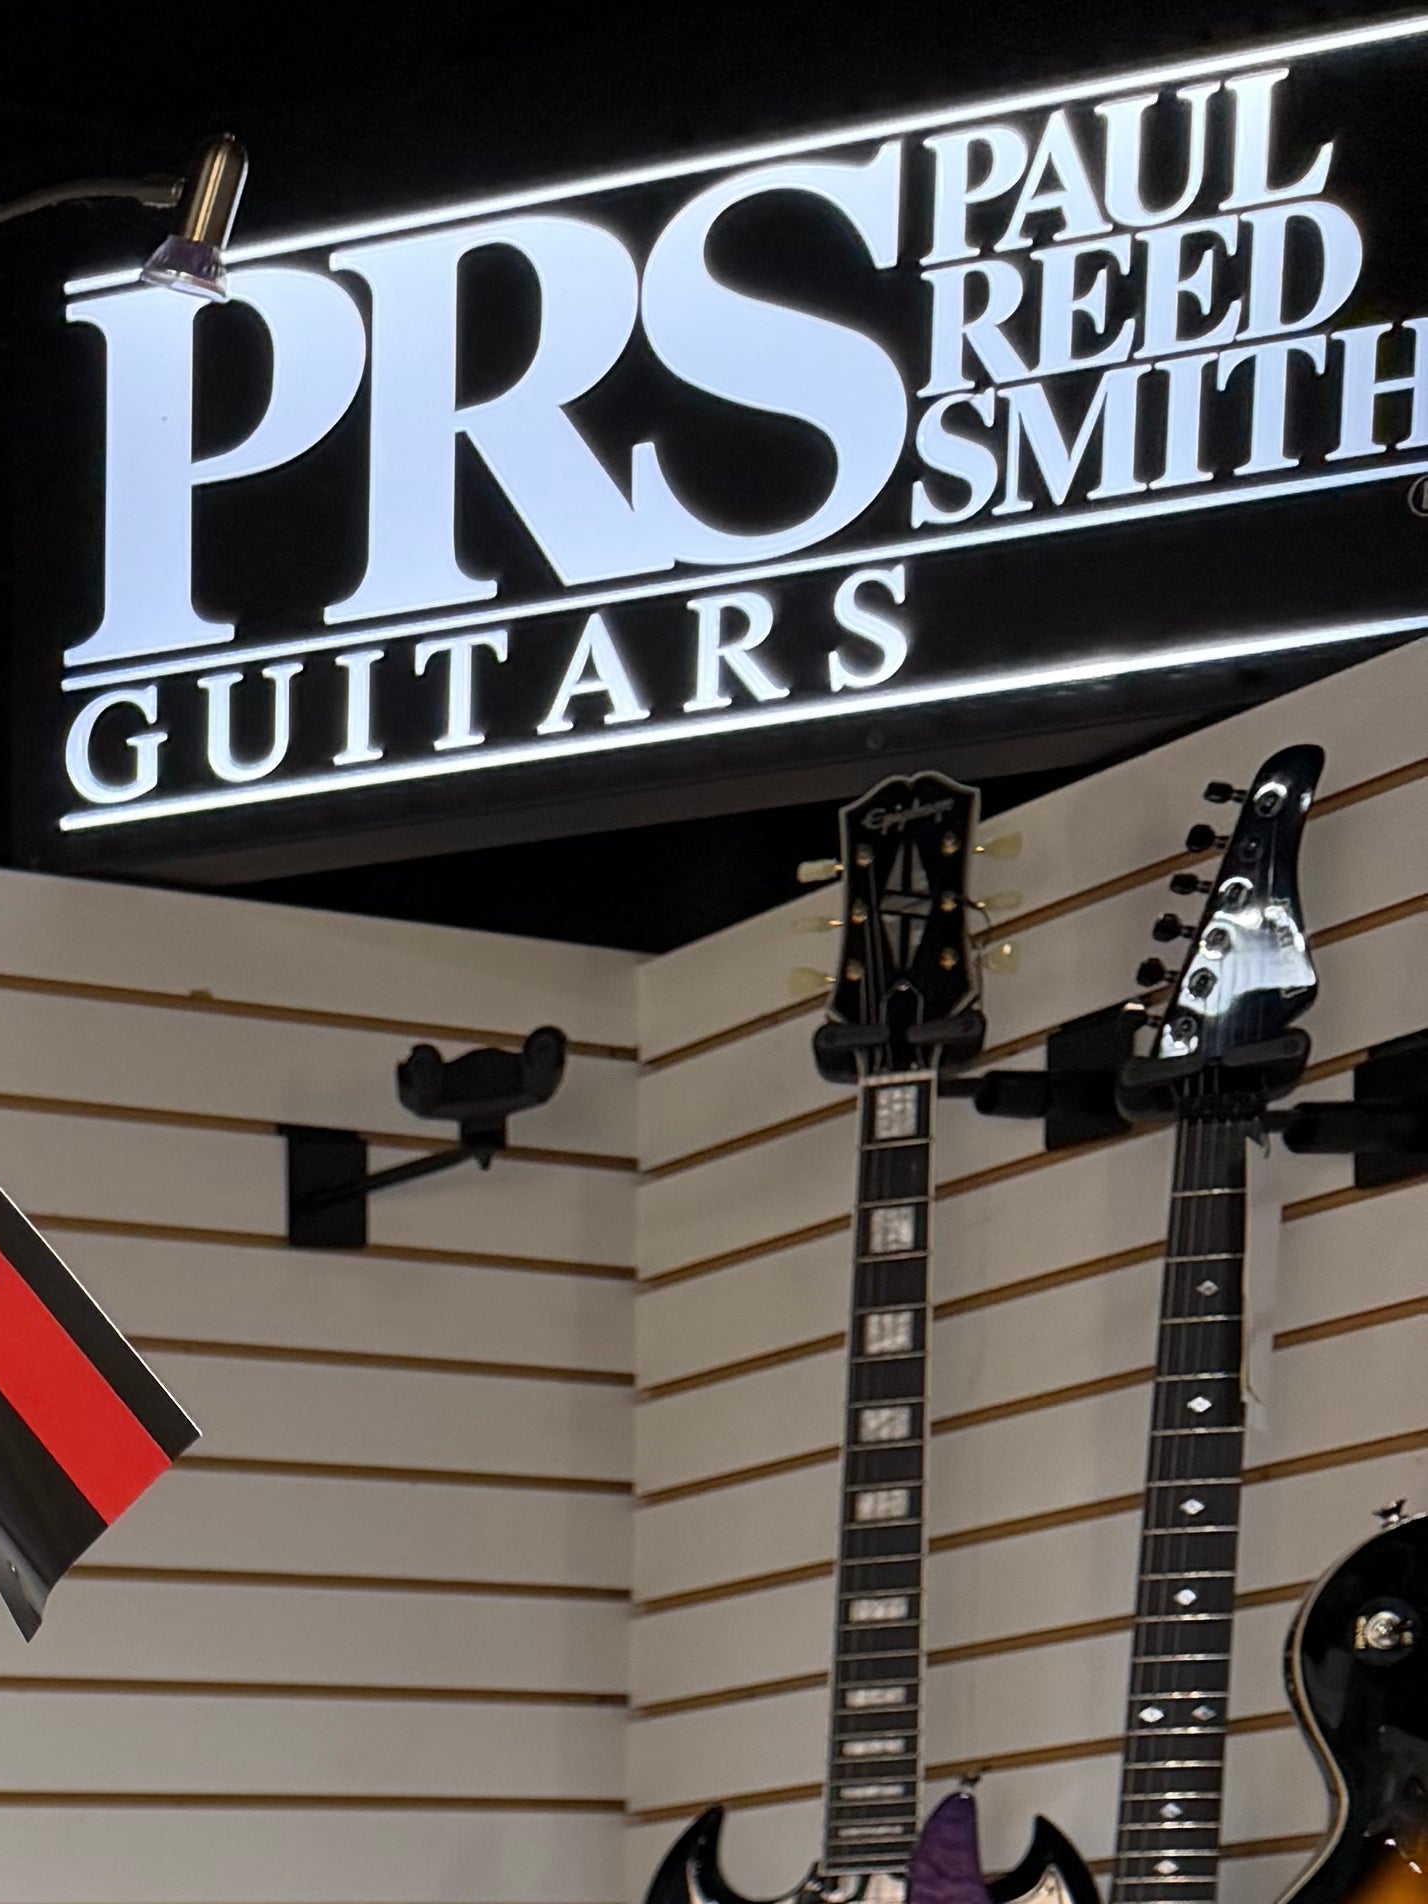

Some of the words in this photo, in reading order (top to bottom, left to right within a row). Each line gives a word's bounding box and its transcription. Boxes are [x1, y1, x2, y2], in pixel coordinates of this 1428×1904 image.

[922, 66, 1336, 268] PAUL
[62, 139, 909, 670] PRS
[917, 199, 1364, 398] REED
[910, 316, 1428, 529] SMITH
[63, 563, 910, 803] GUITARS
